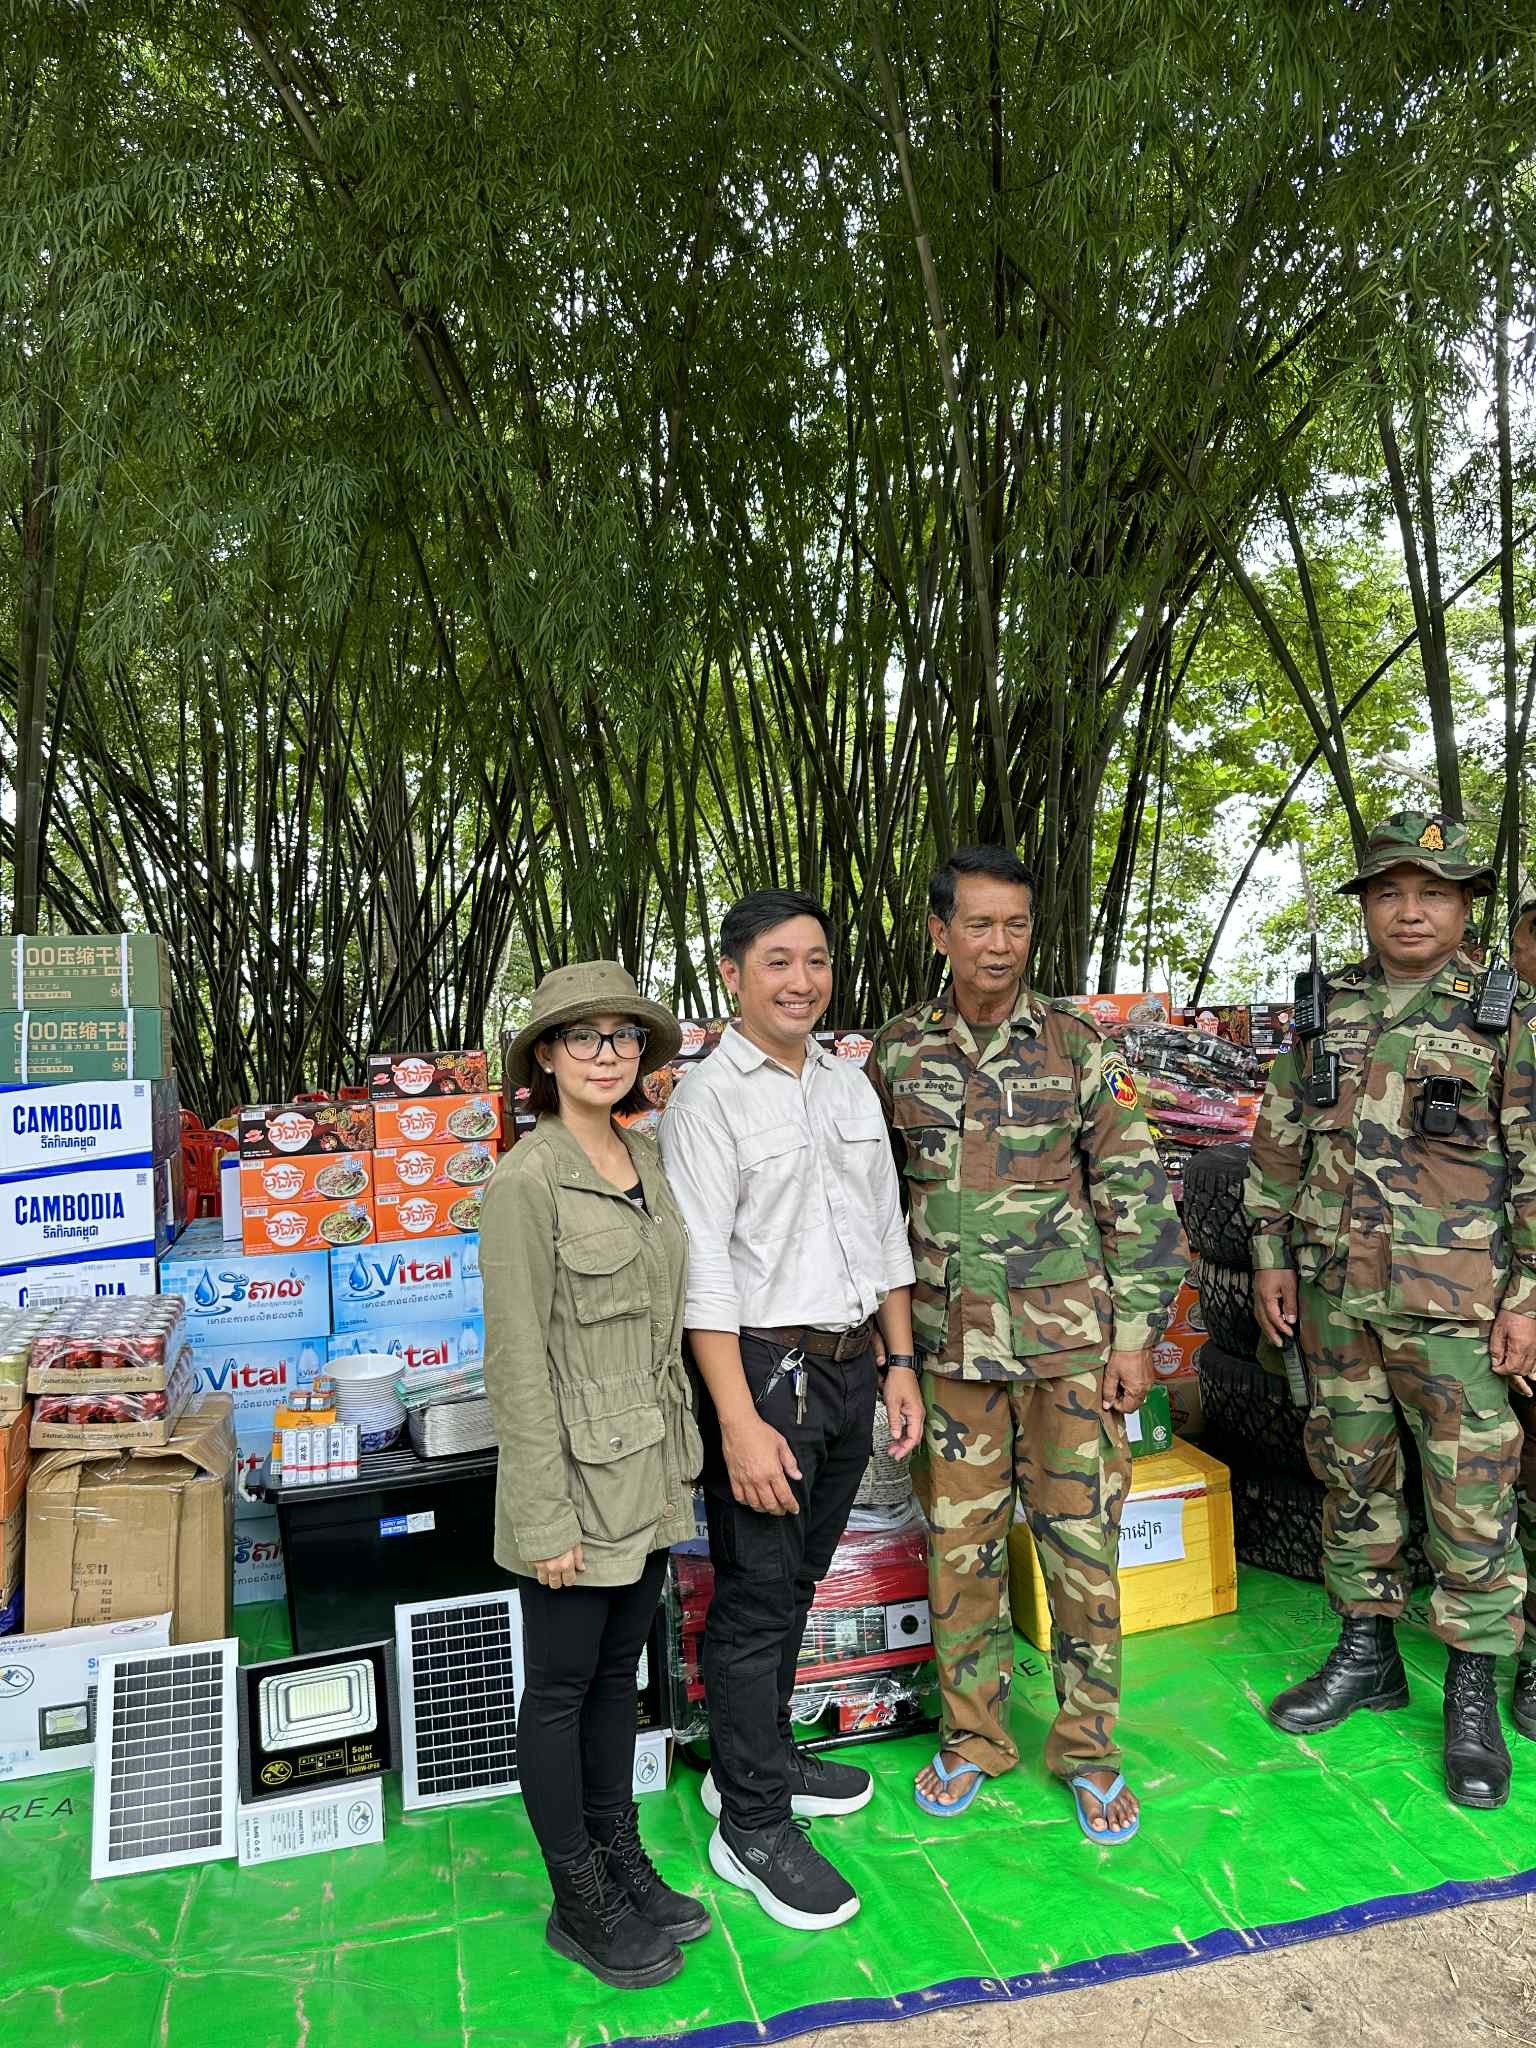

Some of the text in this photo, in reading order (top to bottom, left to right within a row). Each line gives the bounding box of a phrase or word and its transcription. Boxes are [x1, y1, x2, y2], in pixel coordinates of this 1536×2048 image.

[13, 1103, 122, 1135] CAMBODIA
[15, 1192, 124, 1225] CAMBODIA
[372, 1253, 452, 1287] Vital
[203, 1358, 287, 1391] Vital
[352, 1744, 373, 1754] Solar
[353, 1753, 373, 1762] Light
